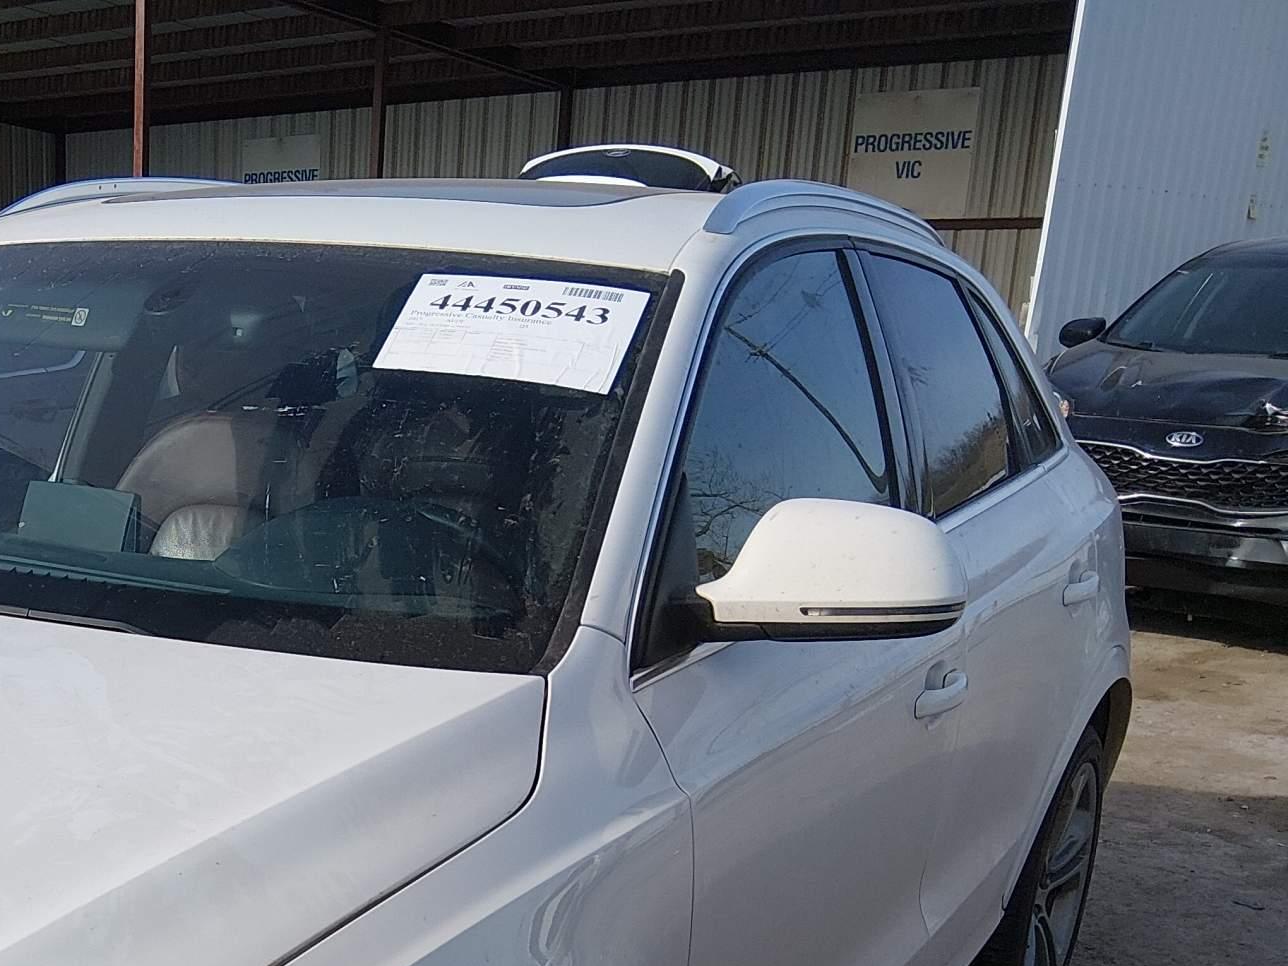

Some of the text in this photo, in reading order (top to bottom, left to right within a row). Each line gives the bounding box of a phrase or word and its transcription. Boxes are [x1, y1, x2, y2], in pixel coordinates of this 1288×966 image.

[854, 130, 973, 153] PROGRESSIVE
[244, 168, 319, 184] PROGRESSIVE
[895, 160, 922, 179] VIC
[410, 309, 462, 318] Progressive
[465, 311, 506, 321] Casualty
[508, 314, 553, 326] Insurance
[429, 293, 611, 326] 44450543
